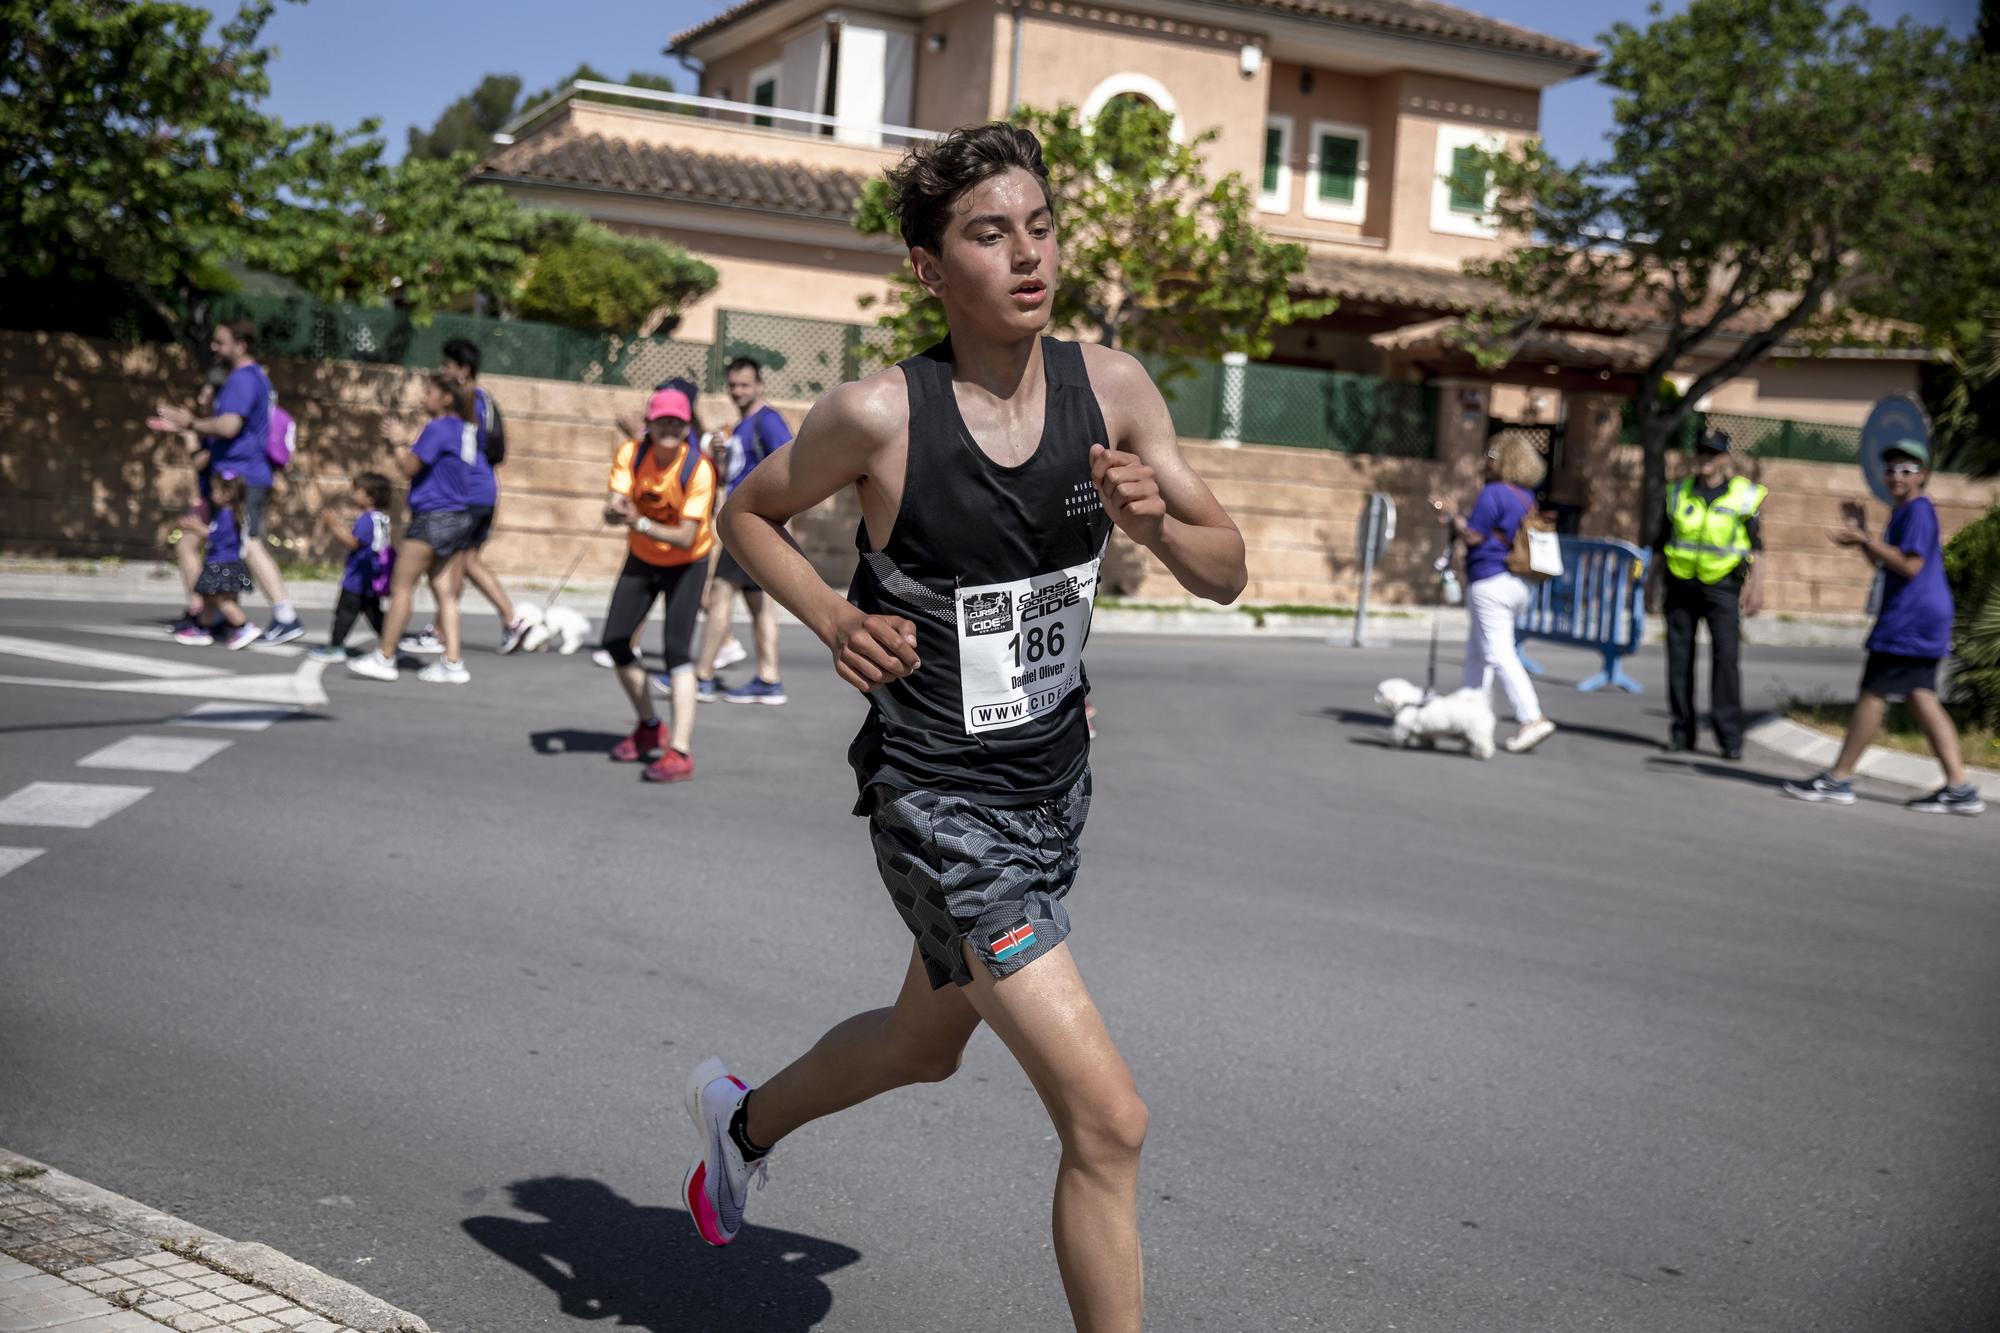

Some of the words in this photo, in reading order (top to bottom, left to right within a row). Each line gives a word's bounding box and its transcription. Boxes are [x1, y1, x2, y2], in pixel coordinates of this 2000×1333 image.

[1073, 480, 1093, 491] NIKE
[1065, 491, 1097, 505] RUNNIN
[1066, 502, 1103, 517] DIVISION
[1018, 576, 1078, 604] CURSA
[969, 607, 1000, 619] CURSA
[1021, 590, 1080, 623] CIDE
[971, 617, 1001, 632] CIDE
[1008, 621, 1065, 668] 186
[1011, 668, 1037, 690] Daniel
[1039, 662, 1065, 680] Oliver
